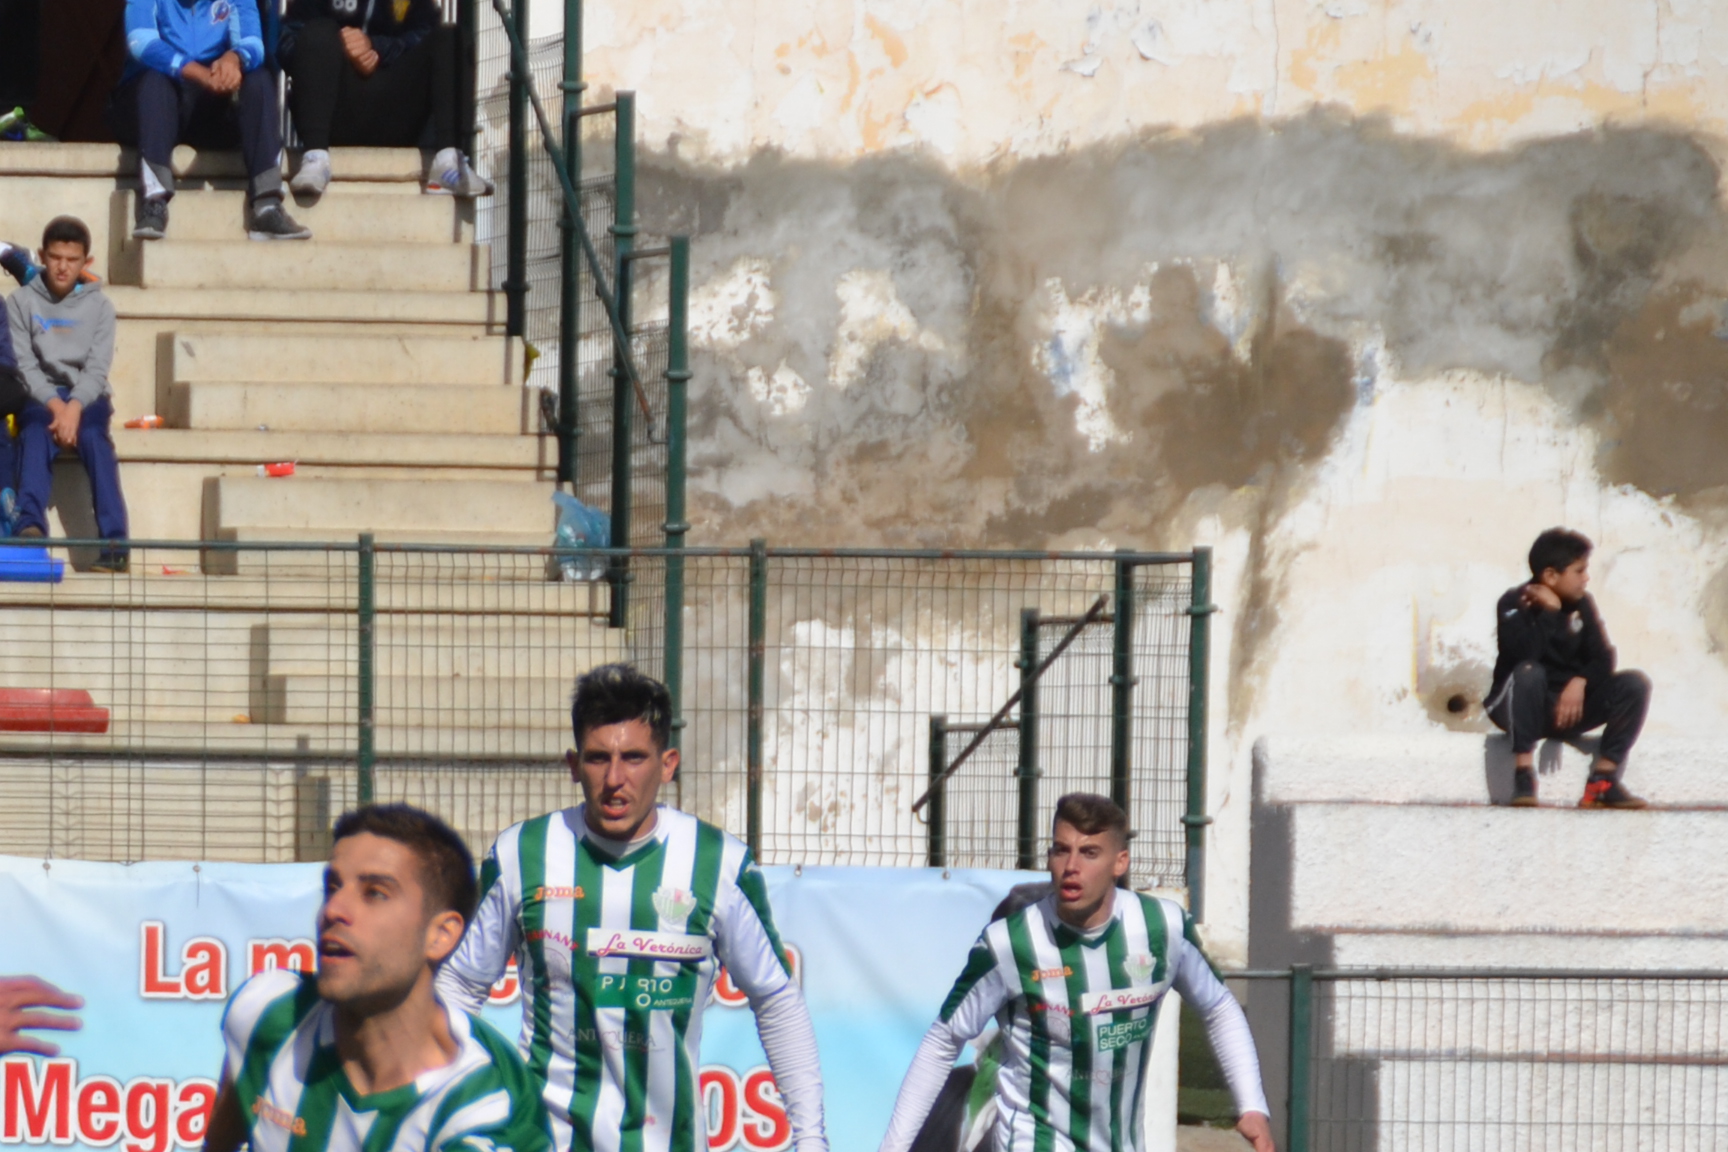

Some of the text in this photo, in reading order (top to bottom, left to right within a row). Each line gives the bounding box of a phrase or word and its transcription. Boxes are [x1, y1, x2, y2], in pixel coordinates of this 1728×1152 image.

[597, 933, 626, 957] La
[633, 937, 703, 956] Verónica
[142, 924, 224, 996] La
[1090, 994, 1113, 1015] La
[1099, 1018, 1147, 1037] PUERTO
[1099, 1034, 1132, 1050] SECO
